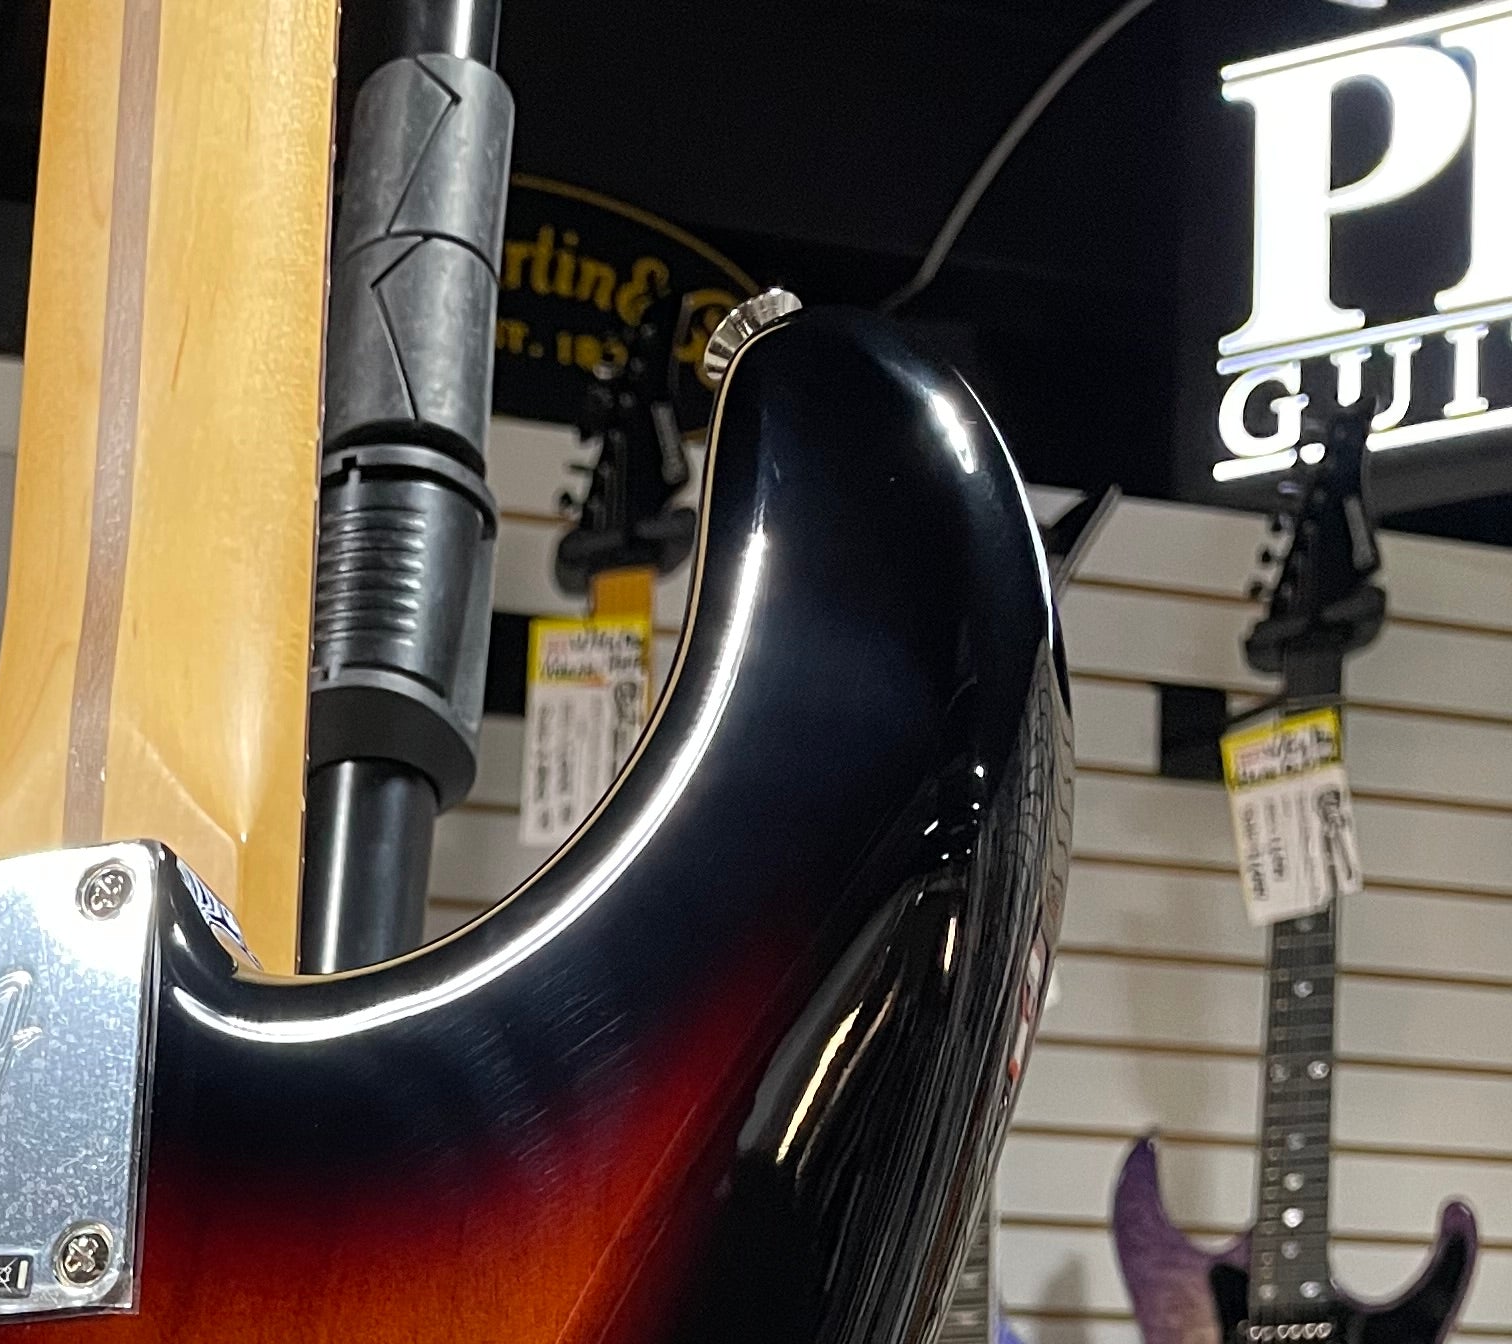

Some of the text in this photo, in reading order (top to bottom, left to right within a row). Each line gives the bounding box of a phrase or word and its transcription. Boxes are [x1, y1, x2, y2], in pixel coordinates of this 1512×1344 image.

[1218, 10, 1512, 355] P
[501, 225, 616, 313] rtin
[1217, 322, 1512, 460] GUI
